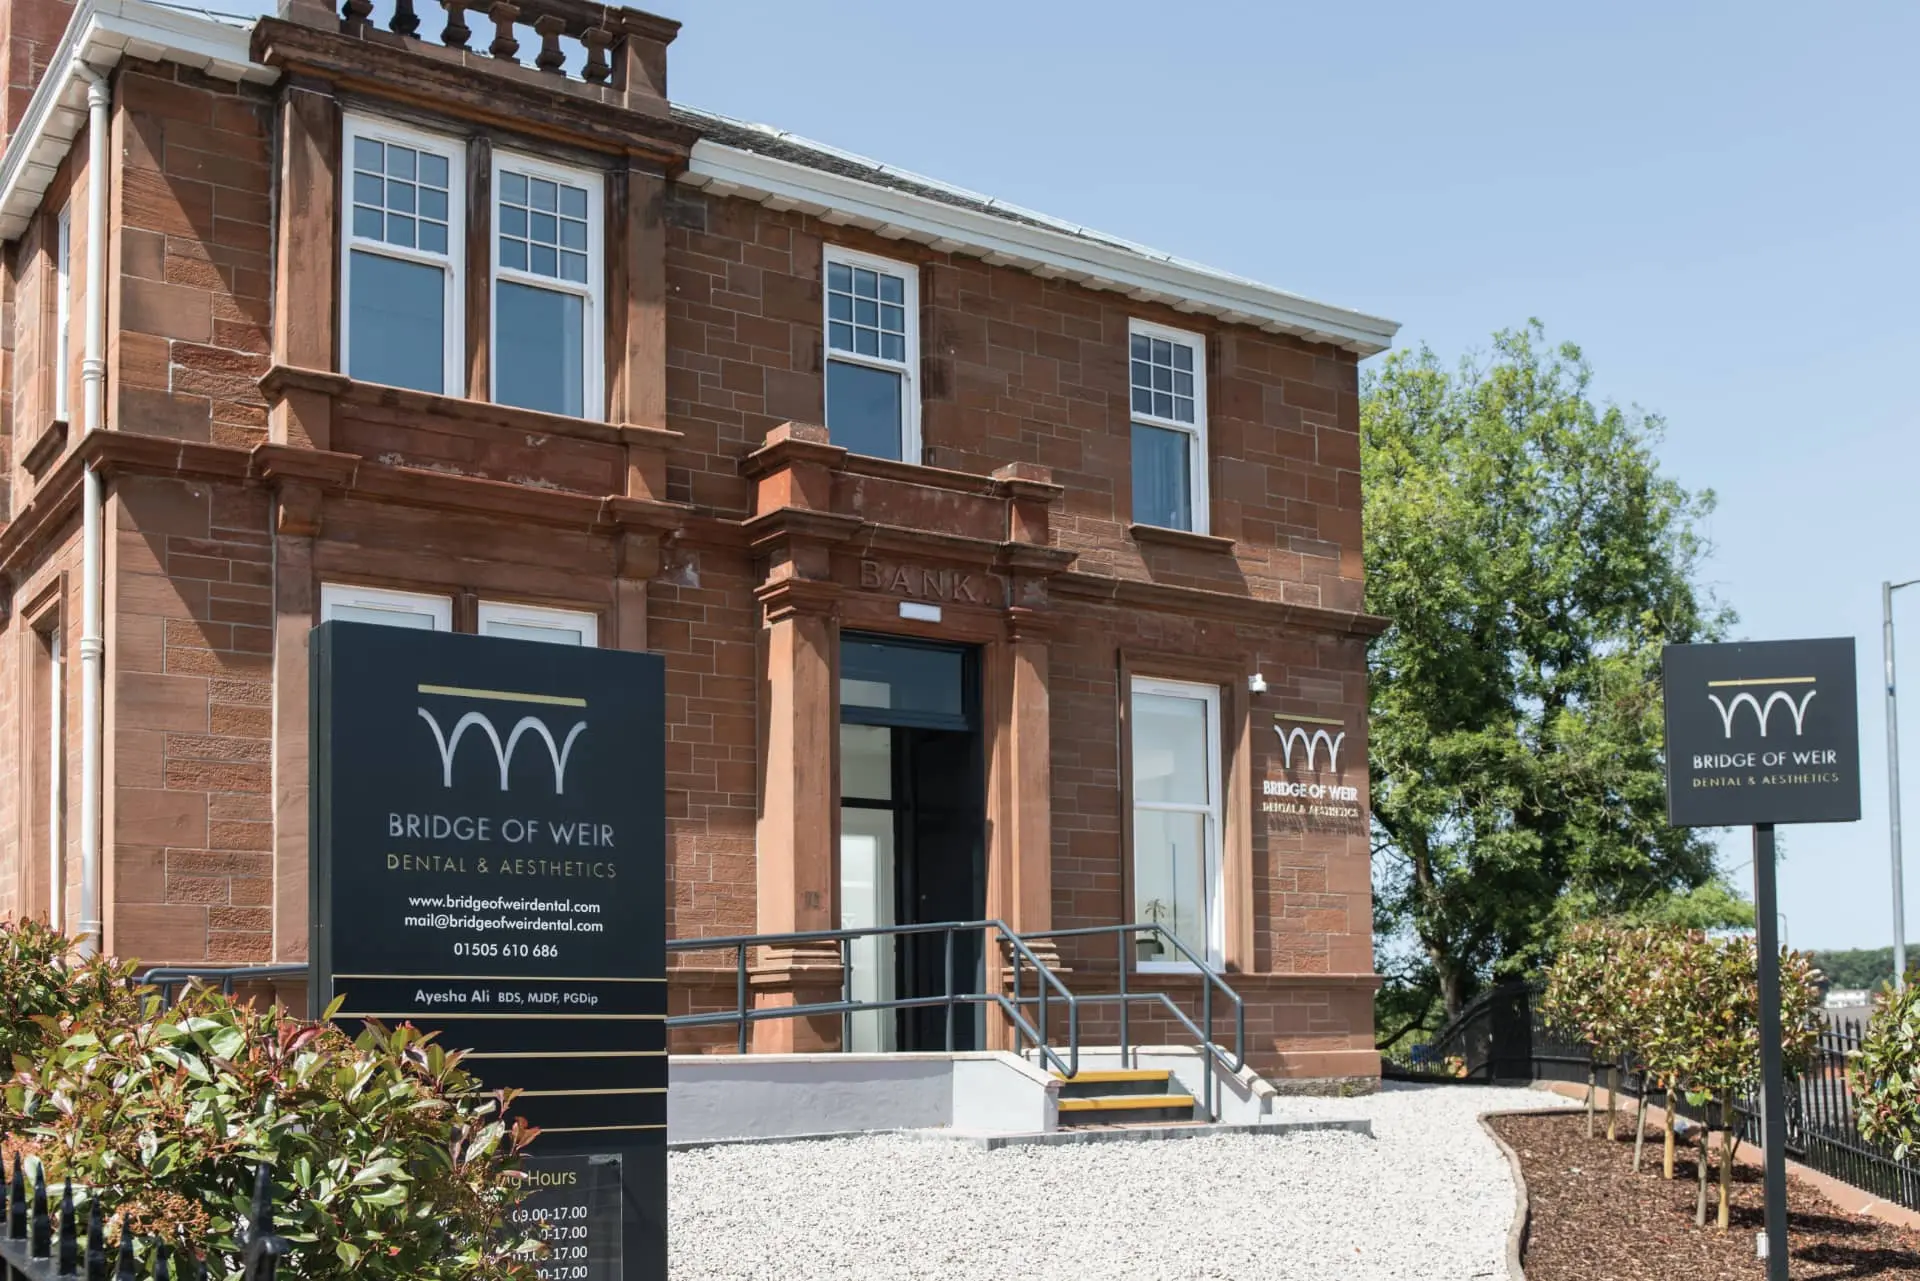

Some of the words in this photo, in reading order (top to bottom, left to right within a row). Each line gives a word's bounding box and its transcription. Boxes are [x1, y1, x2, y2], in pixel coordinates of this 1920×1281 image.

[1693, 753, 1756, 769] BRIDGE
[1762, 751, 1787, 767] OF
[1793, 749, 1837, 766] WEIR
[1692, 776, 1742, 788] DENTAL
[1748, 775, 1756, 786] &
[1762, 772, 1839, 786] AESTHETICS
[1263, 780, 1307, 798] BRIDGE
[1308, 784, 1327, 799] OF
[1327, 785, 1358, 801] WEIR
[389, 813, 491, 841] BRIDGE
[502, 819, 539, 843] OF
[549, 821, 615, 847] WEIR
[387, 853, 467, 873] DENTAL
[477, 857, 489, 873] &
[500, 859, 616, 878] AESTHETICS
[408, 894, 601, 913] www.bridgeofweirdental.com
[404, 913, 604, 932] mail@bridgeofweirdental.com
[454, 942, 498, 957] 01505
[502, 943, 528, 957] 610
[532, 943, 558, 957] 686
[415, 989, 467, 1005] Ayesha
[471, 989, 490, 1002] Ali
[498, 992, 524, 1005] BDS,
[527, 992, 560, 1006] MJDF,
[564, 992, 599, 1006] PGDip
[528, 1170, 577, 1187] Hours
